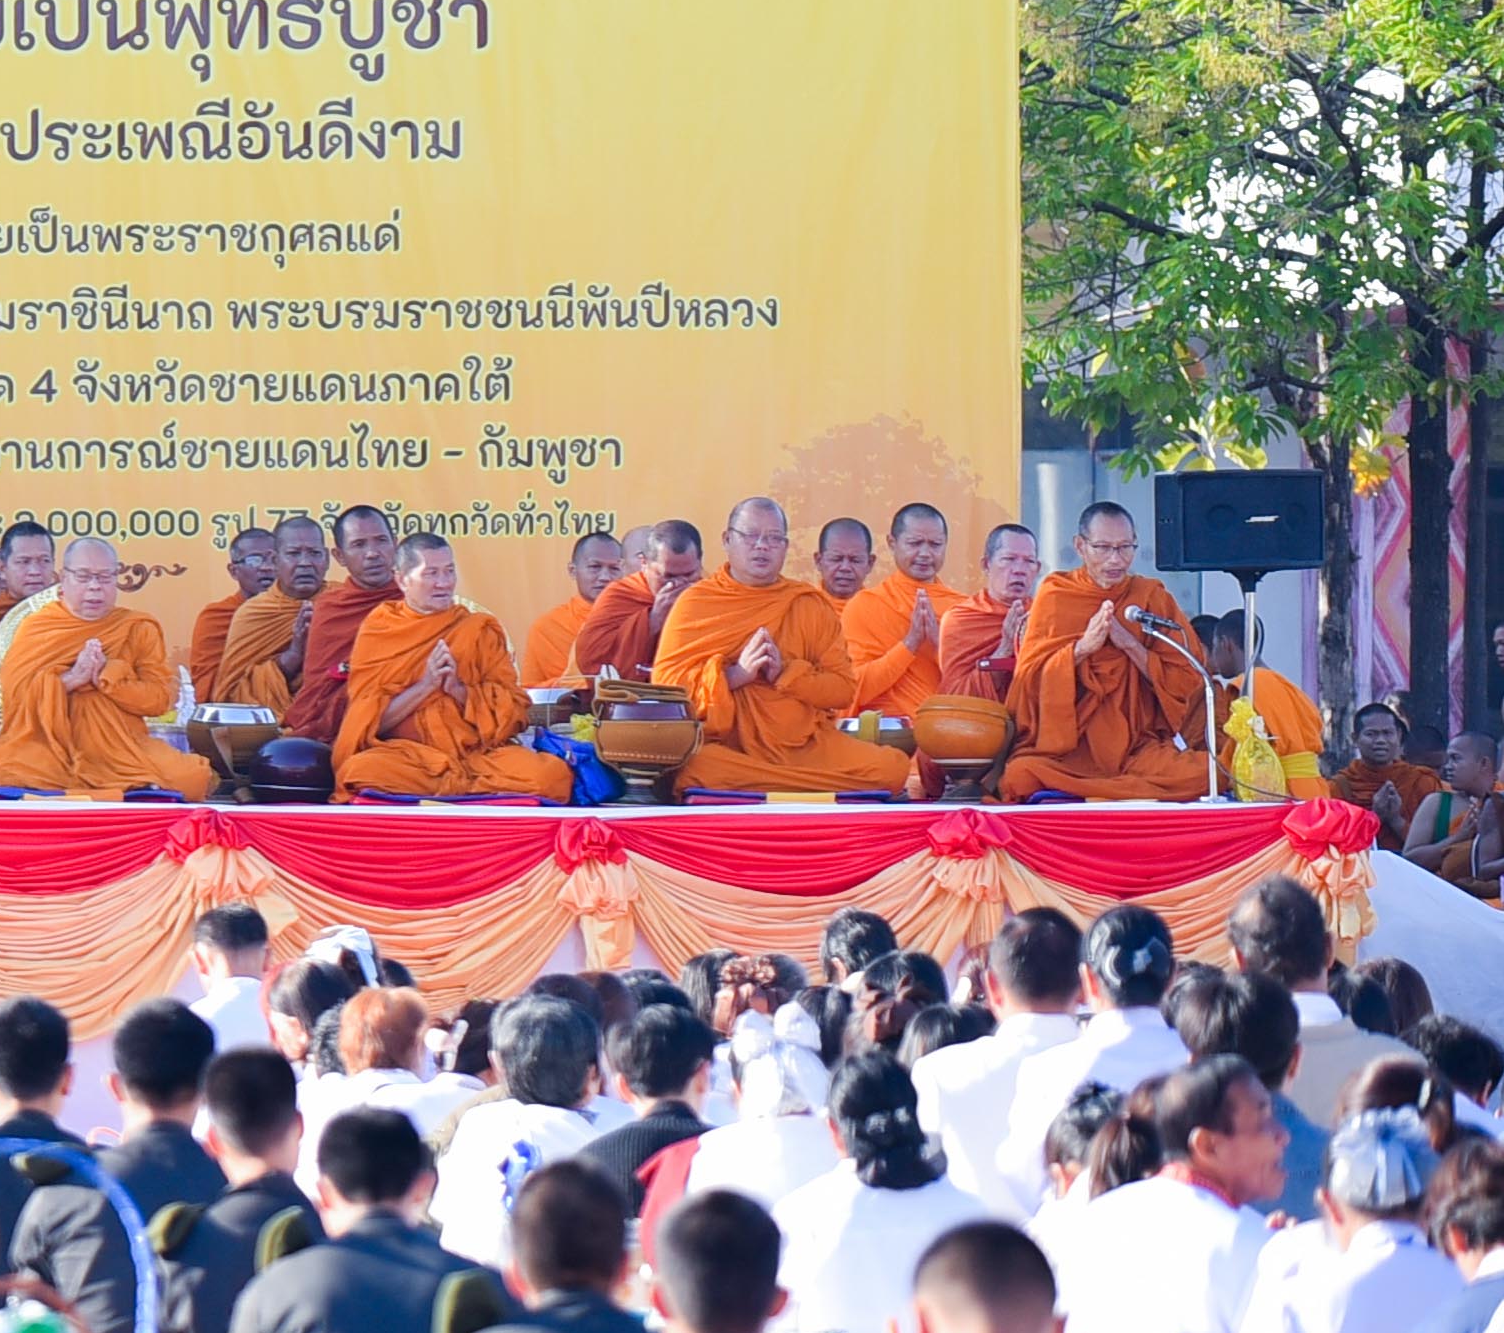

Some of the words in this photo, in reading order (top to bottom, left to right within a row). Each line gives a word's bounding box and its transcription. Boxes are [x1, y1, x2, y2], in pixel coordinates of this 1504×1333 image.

[226, 281, 779, 331] พระบรมราชชนนีพันปีหลวง
[29, 368, 58, 404] 4
[72, 355, 513, 404] จังหวัดชายแดนภาคใต้
[478, 423, 622, 485] กัมพูชา
